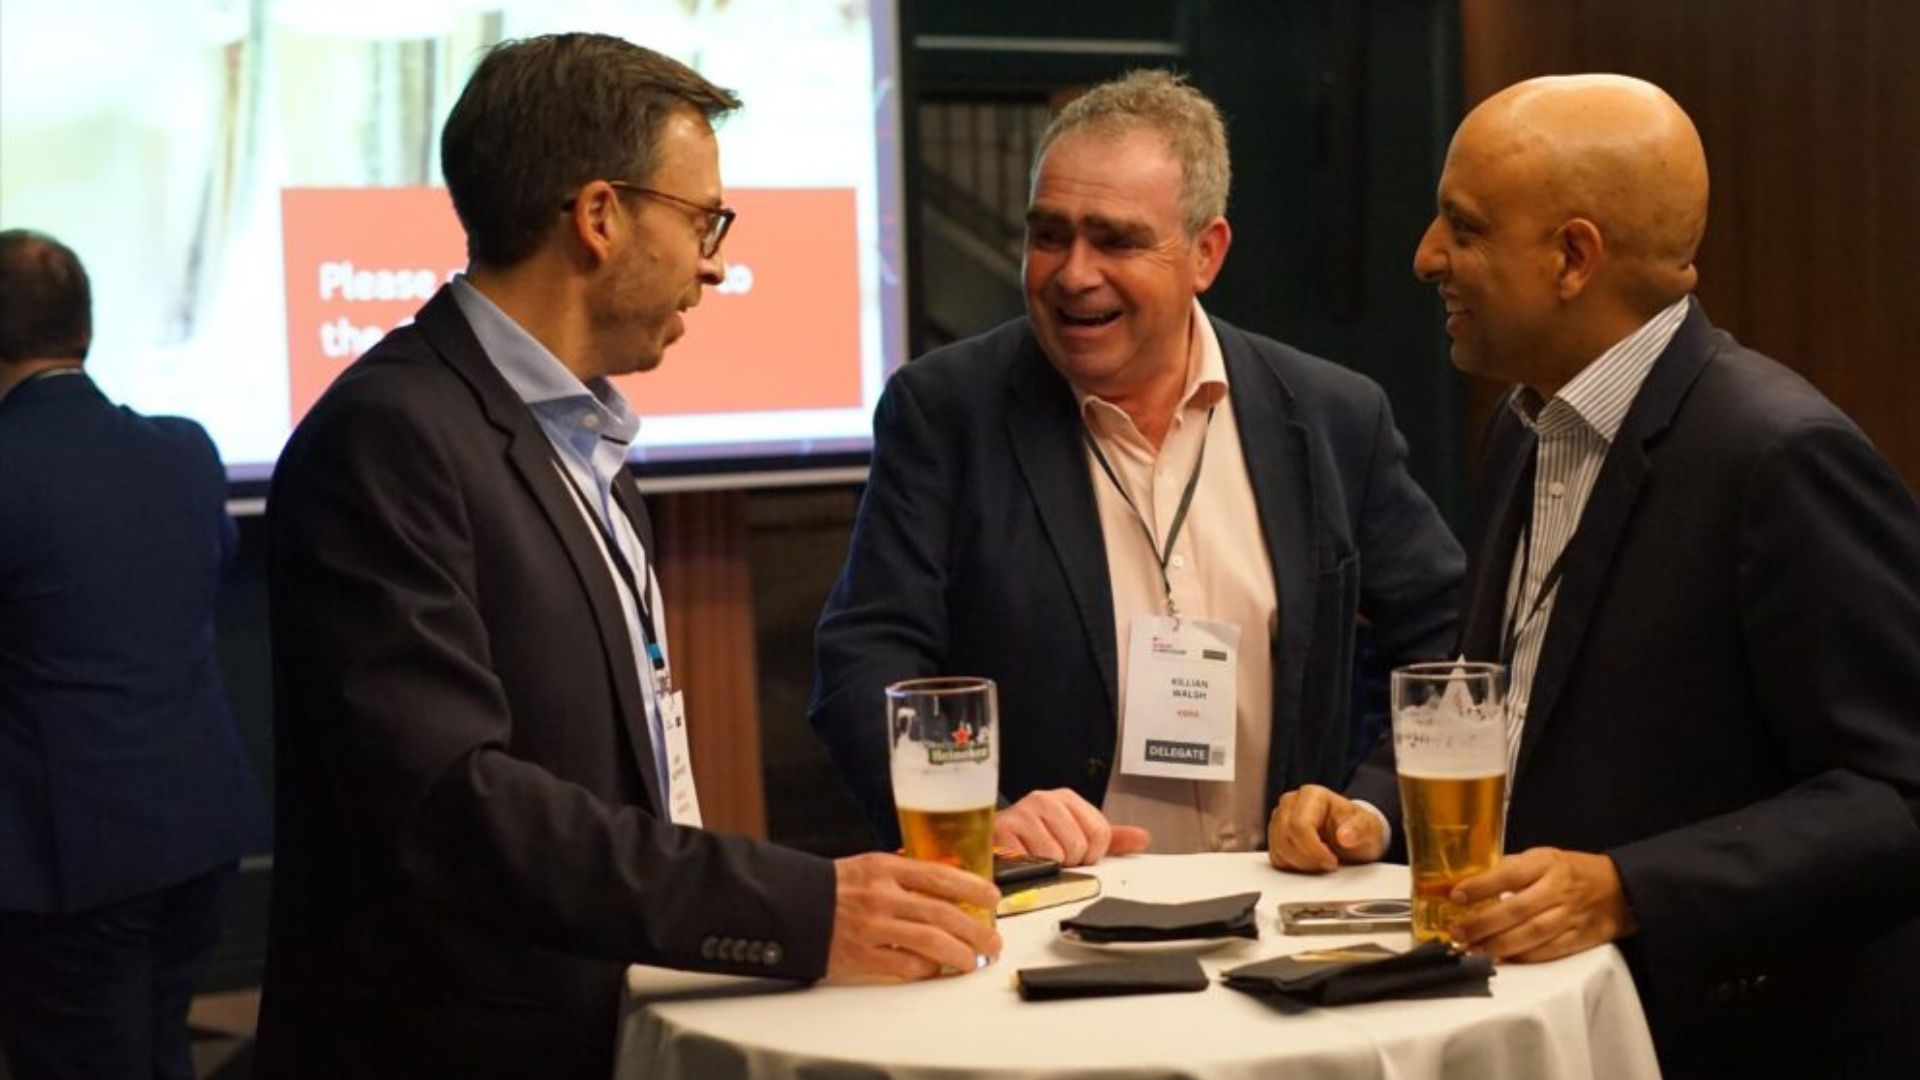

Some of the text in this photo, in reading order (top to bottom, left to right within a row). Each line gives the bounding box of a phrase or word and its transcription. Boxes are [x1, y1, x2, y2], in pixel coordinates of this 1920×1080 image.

[319, 261, 436, 301] Please
[1171, 677, 1208, 688] KILLIAN
[1172, 689, 1206, 700] WALSH
[1148, 745, 1207, 760] DELEGATE
